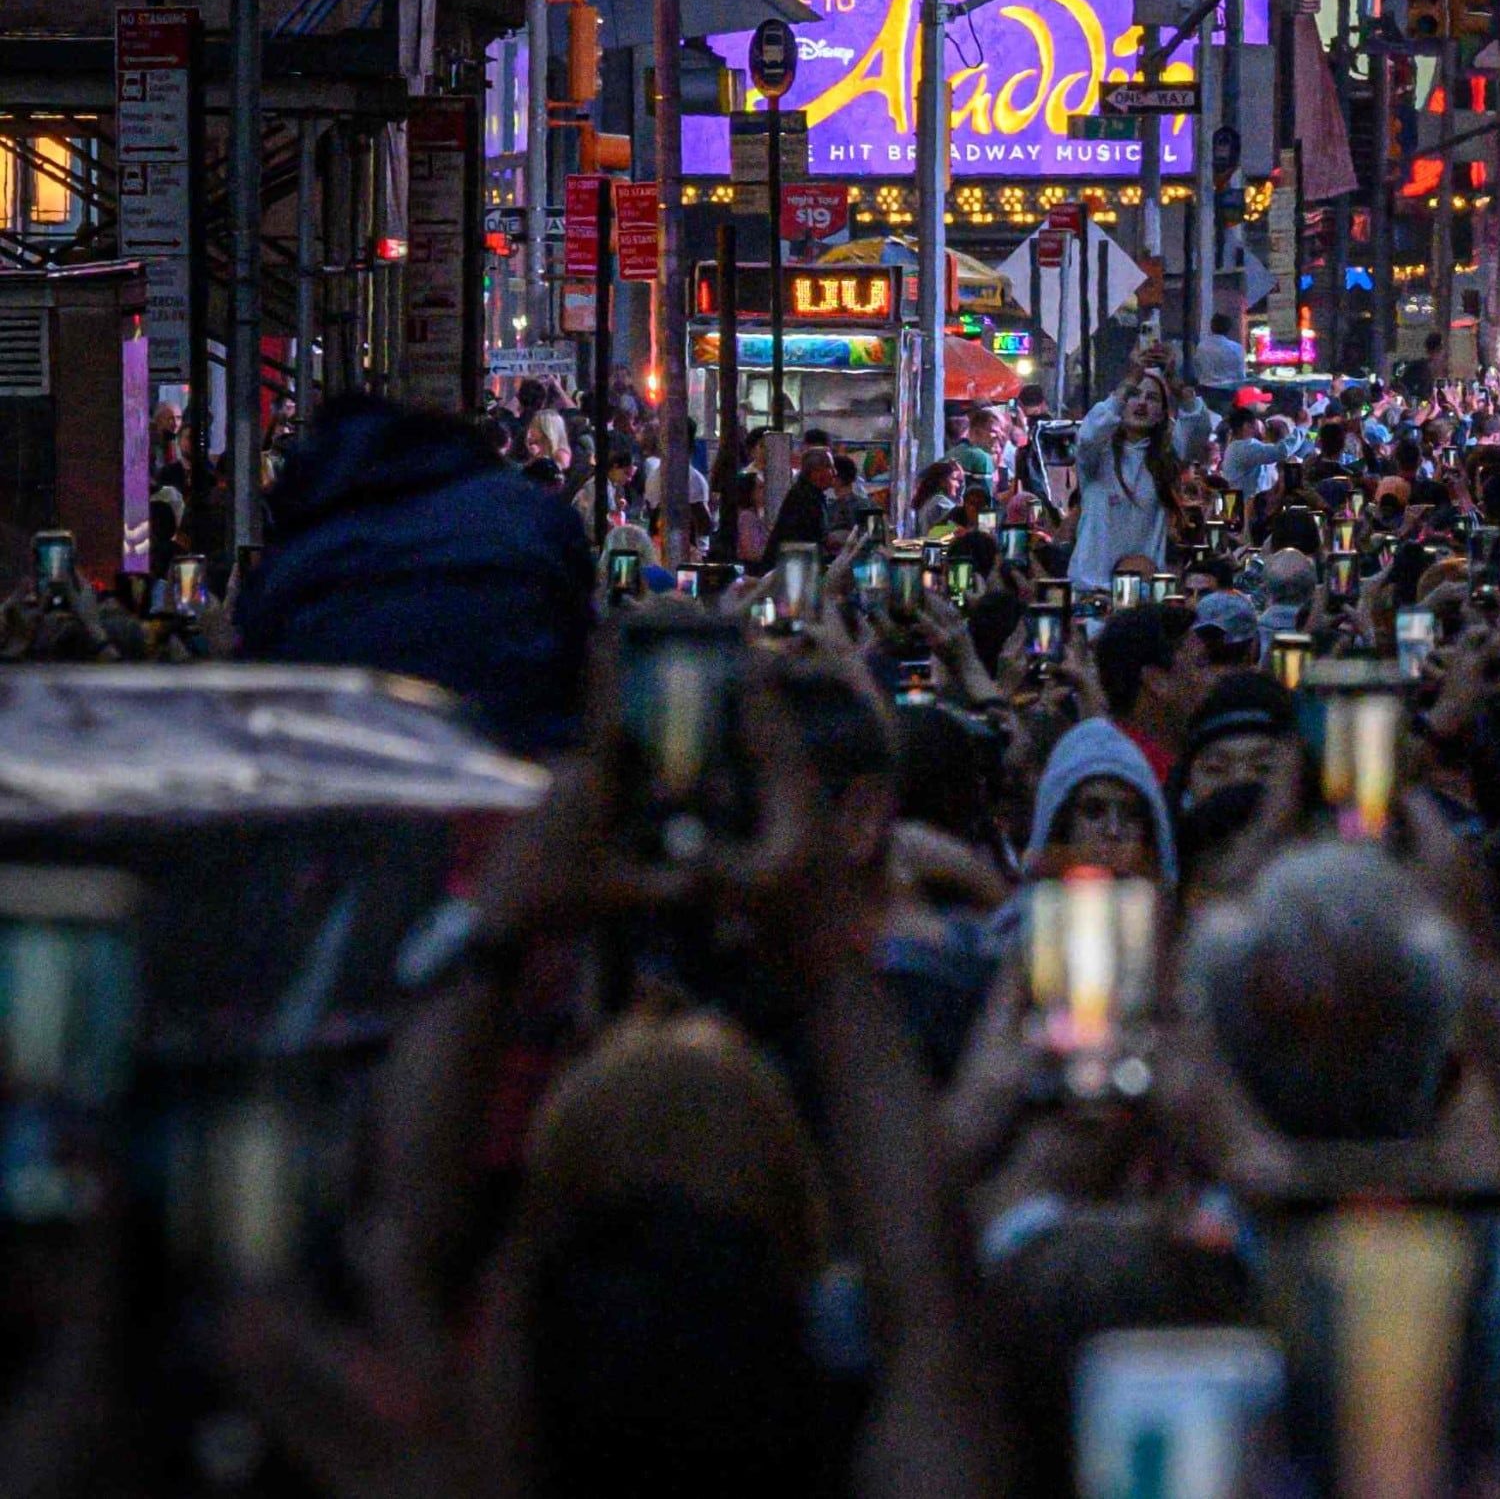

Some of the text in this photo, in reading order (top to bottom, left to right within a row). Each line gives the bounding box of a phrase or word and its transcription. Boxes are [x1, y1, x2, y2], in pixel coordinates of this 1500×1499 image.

[1156, 89, 1189, 105] WAY
[829, 143, 874, 162] HIT
[1055, 142, 1178, 163] MUSICL
[795, 207, 832, 229] $19
